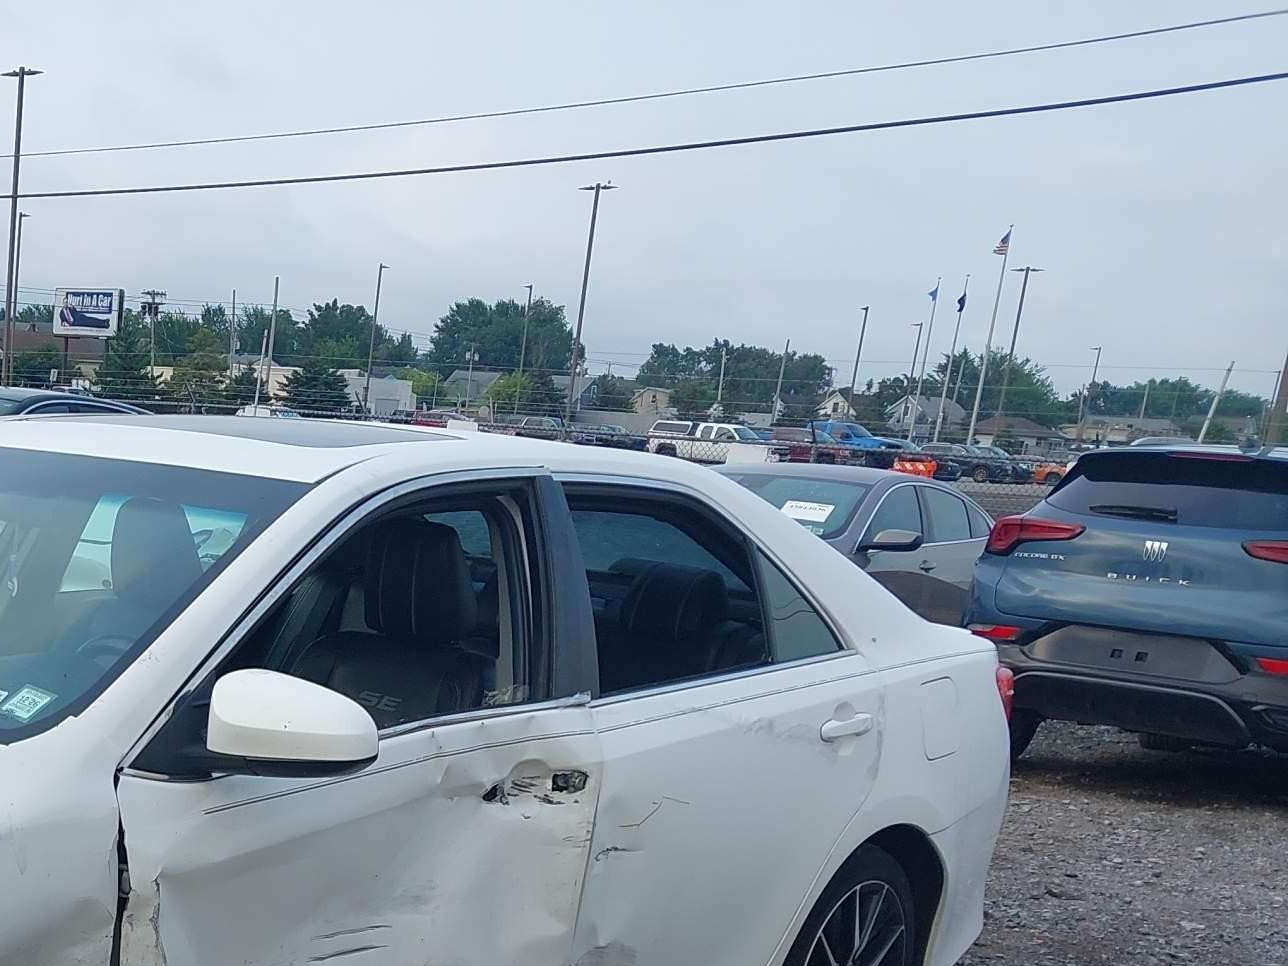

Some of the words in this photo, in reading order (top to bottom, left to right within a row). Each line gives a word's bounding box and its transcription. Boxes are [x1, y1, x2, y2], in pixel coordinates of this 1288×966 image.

[68, 293, 83, 306] Hurt
[83, 294, 92, 306] In
[92, 294, 97, 306] A
[98, 294, 111, 307] Car
[1107, 572, 1191, 586] BUICK
[360, 690, 402, 712] SE
